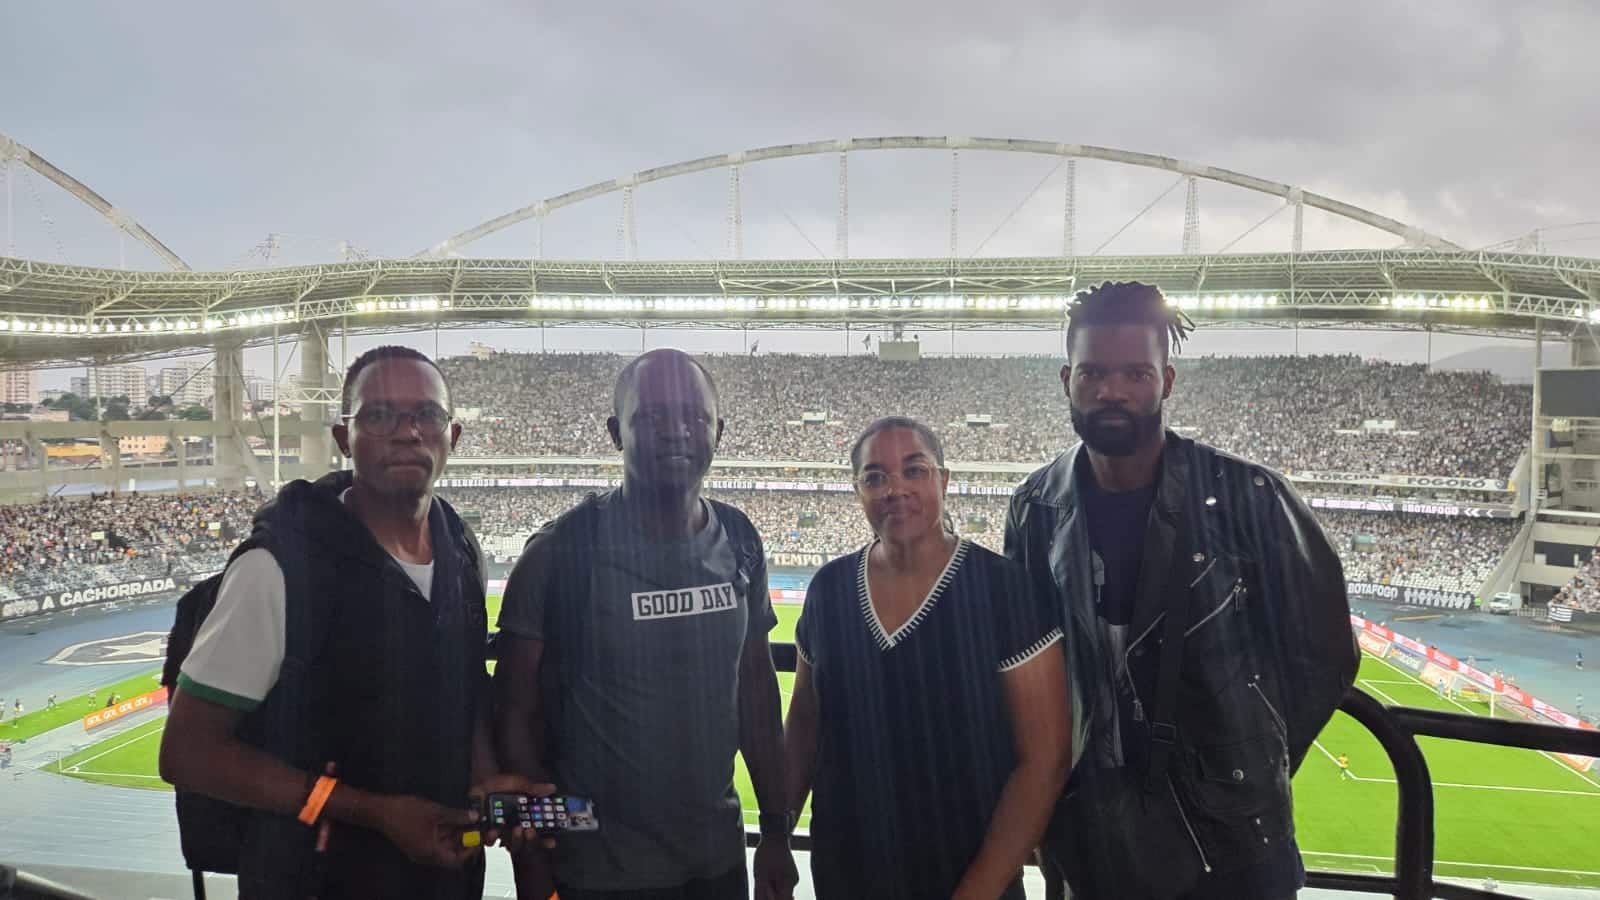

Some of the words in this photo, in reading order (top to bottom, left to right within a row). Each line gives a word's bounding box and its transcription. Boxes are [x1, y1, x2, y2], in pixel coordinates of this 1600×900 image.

[774, 553, 823, 567] TEMPO
[42, 596, 55, 610] A
[60, 577, 175, 606] CACHORRADA
[637, 593, 694, 616] GOOD
[700, 586, 733, 610] DAY
[1347, 582, 1399, 600] BOTAFOGO
